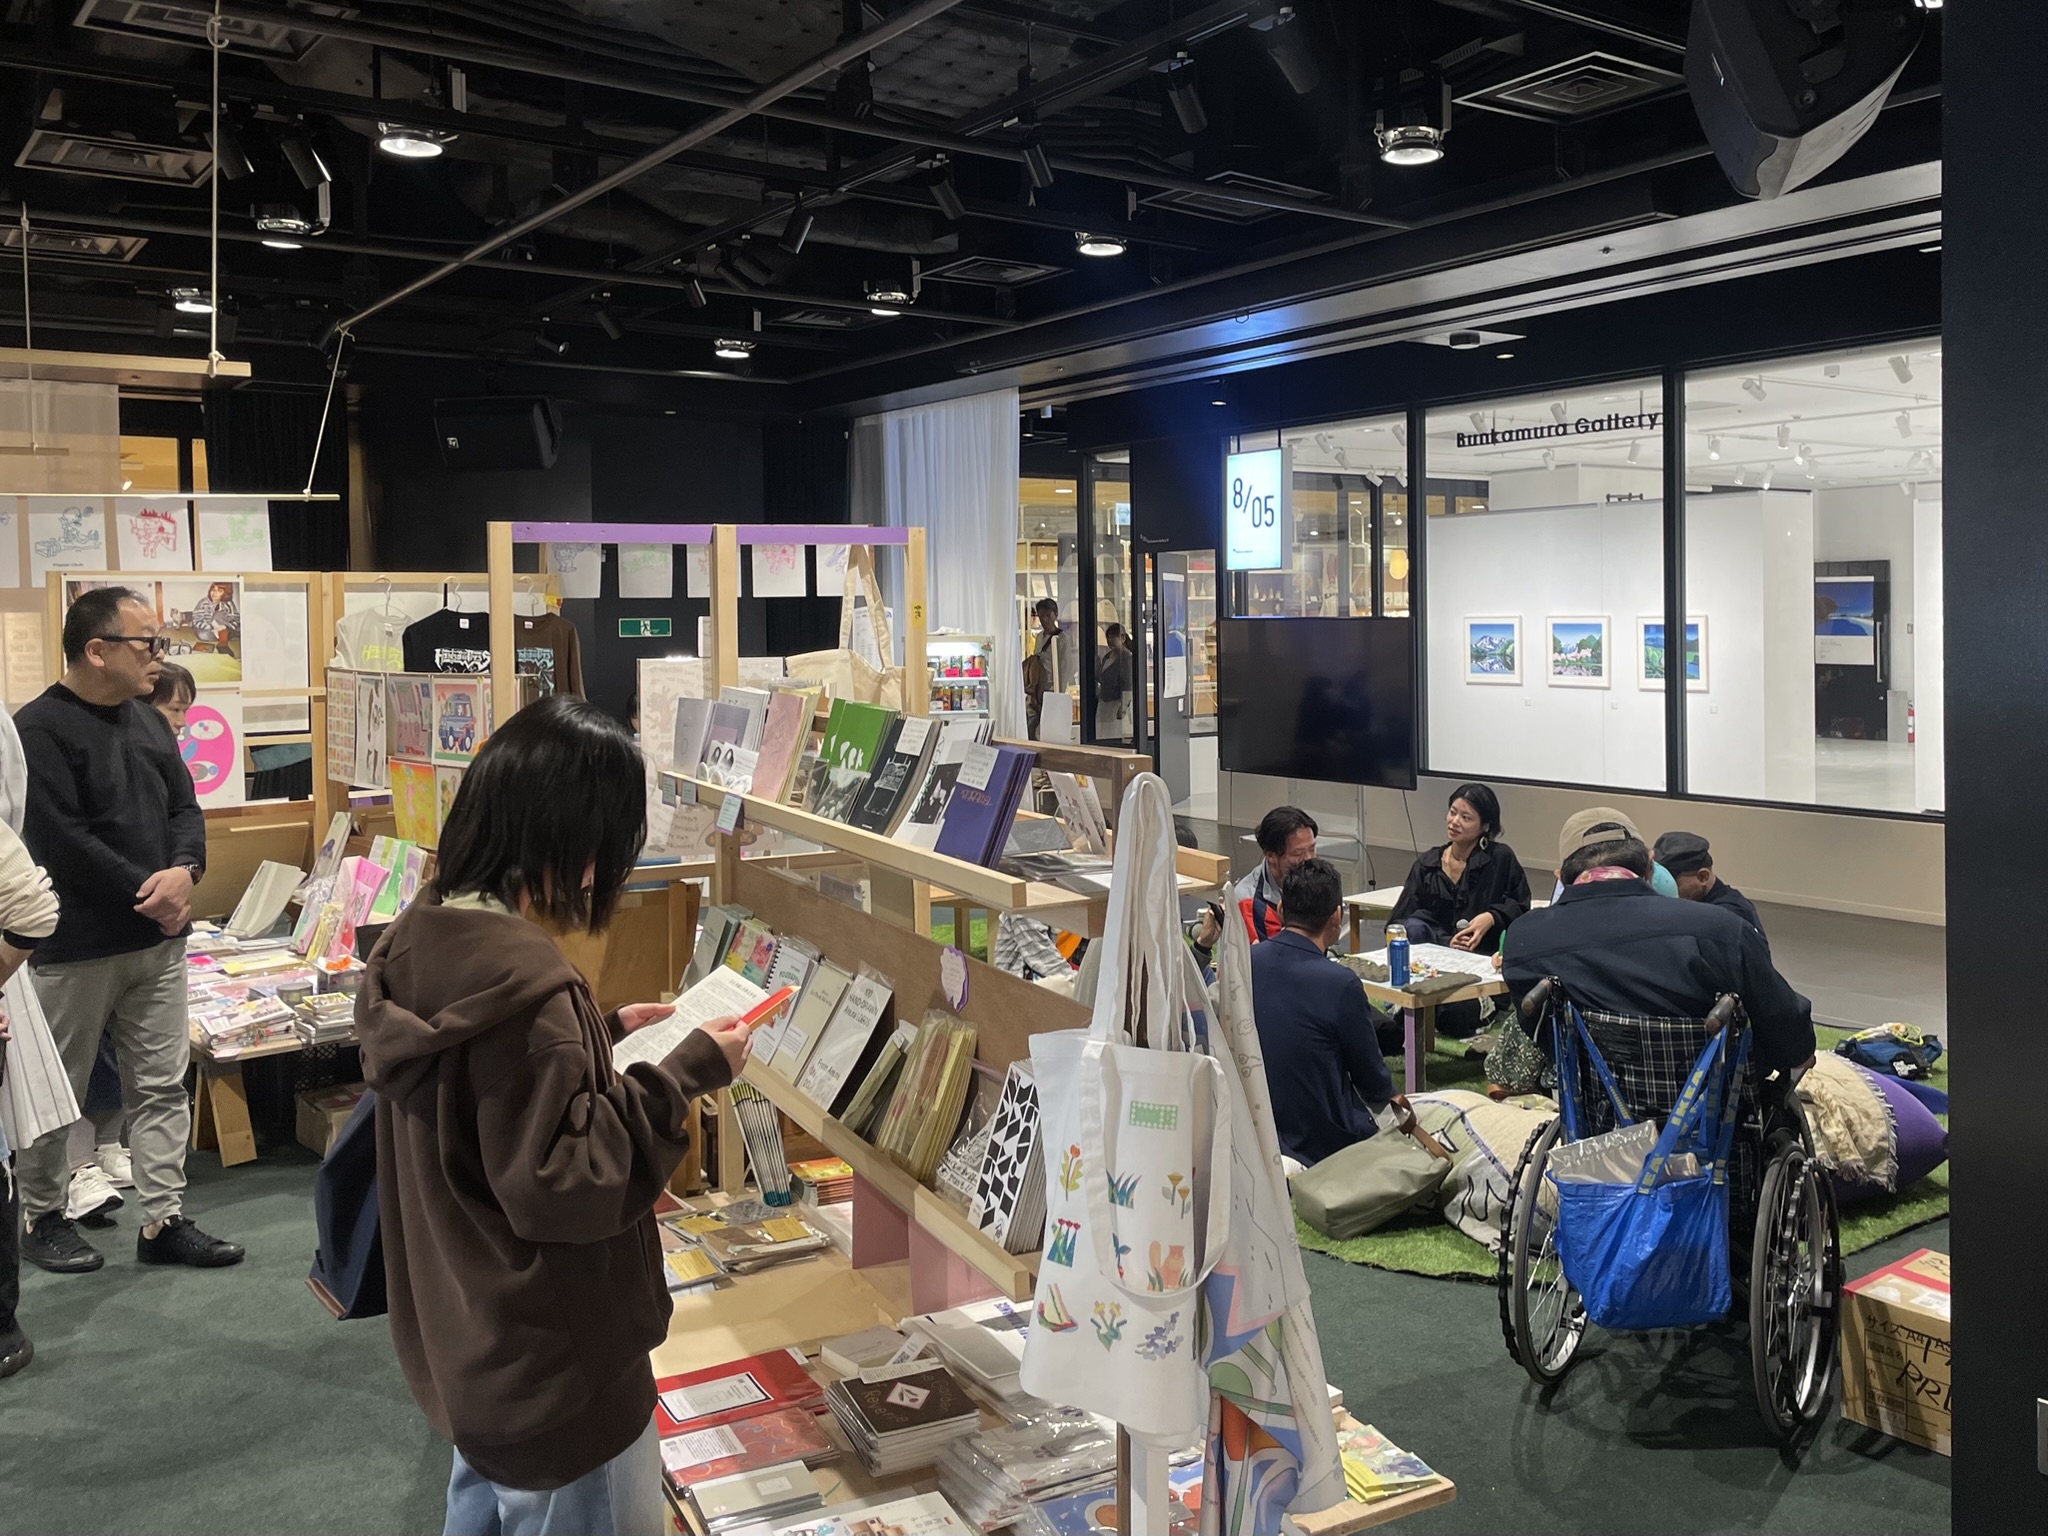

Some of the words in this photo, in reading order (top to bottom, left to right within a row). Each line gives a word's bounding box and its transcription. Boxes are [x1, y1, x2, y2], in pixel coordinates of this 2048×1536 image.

[1457, 422, 1569, 448] Bunkamura
[1574, 412, 1660, 435] Gallery
[1232, 477, 1275, 529] 8/05
[1671, 1070, 1704, 1126] IKEA
[1866, 1314, 1903, 1337] サイズ
